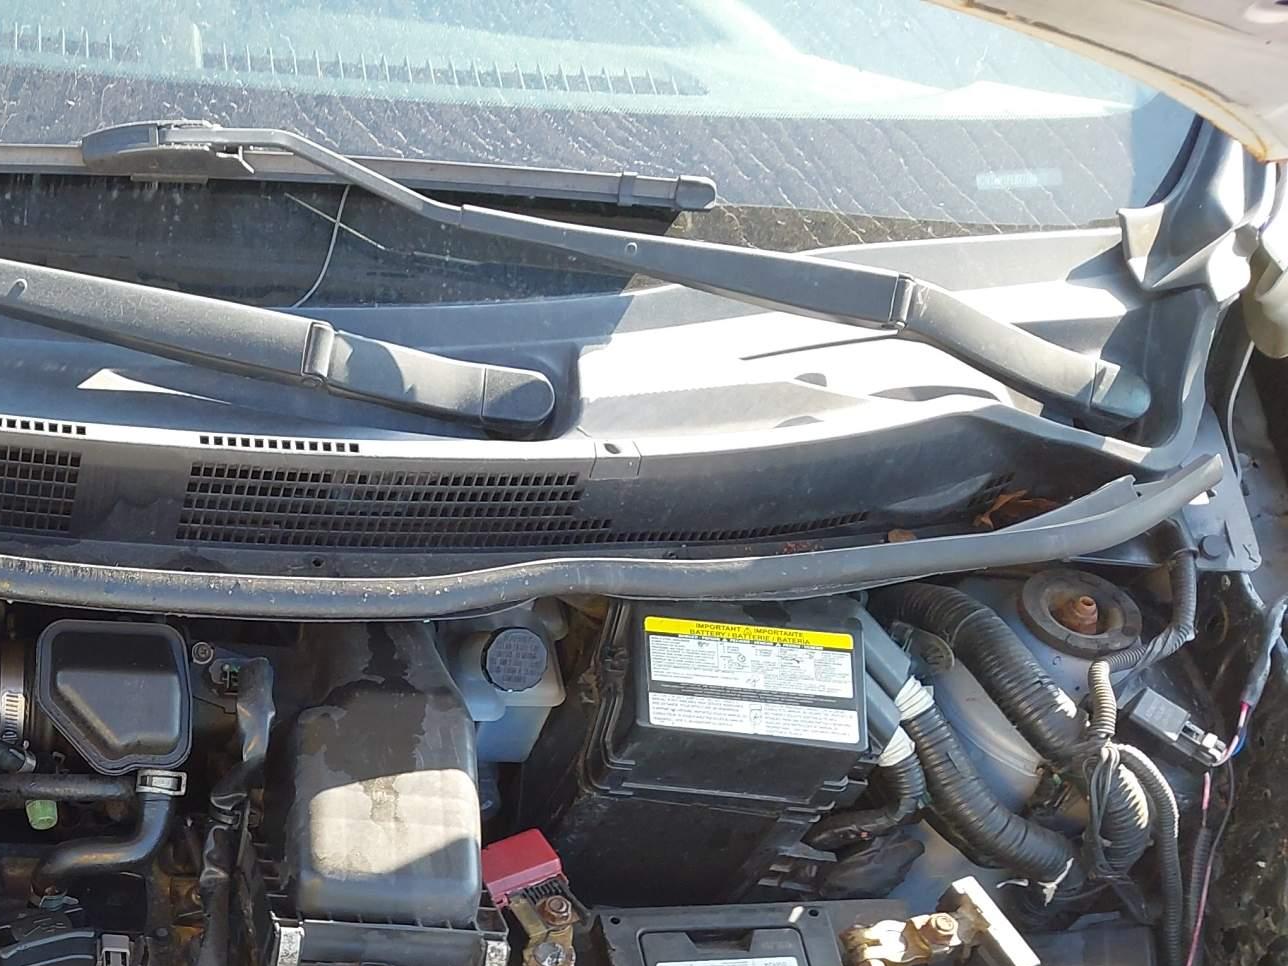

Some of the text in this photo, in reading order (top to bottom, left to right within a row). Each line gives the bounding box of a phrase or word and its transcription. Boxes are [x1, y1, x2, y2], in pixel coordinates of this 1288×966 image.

[689, 629, 726, 637] BATTERY
[732, 632, 771, 641] BATTERIE
[695, 623, 804, 637] IMPORTANT IMPORTANTE
